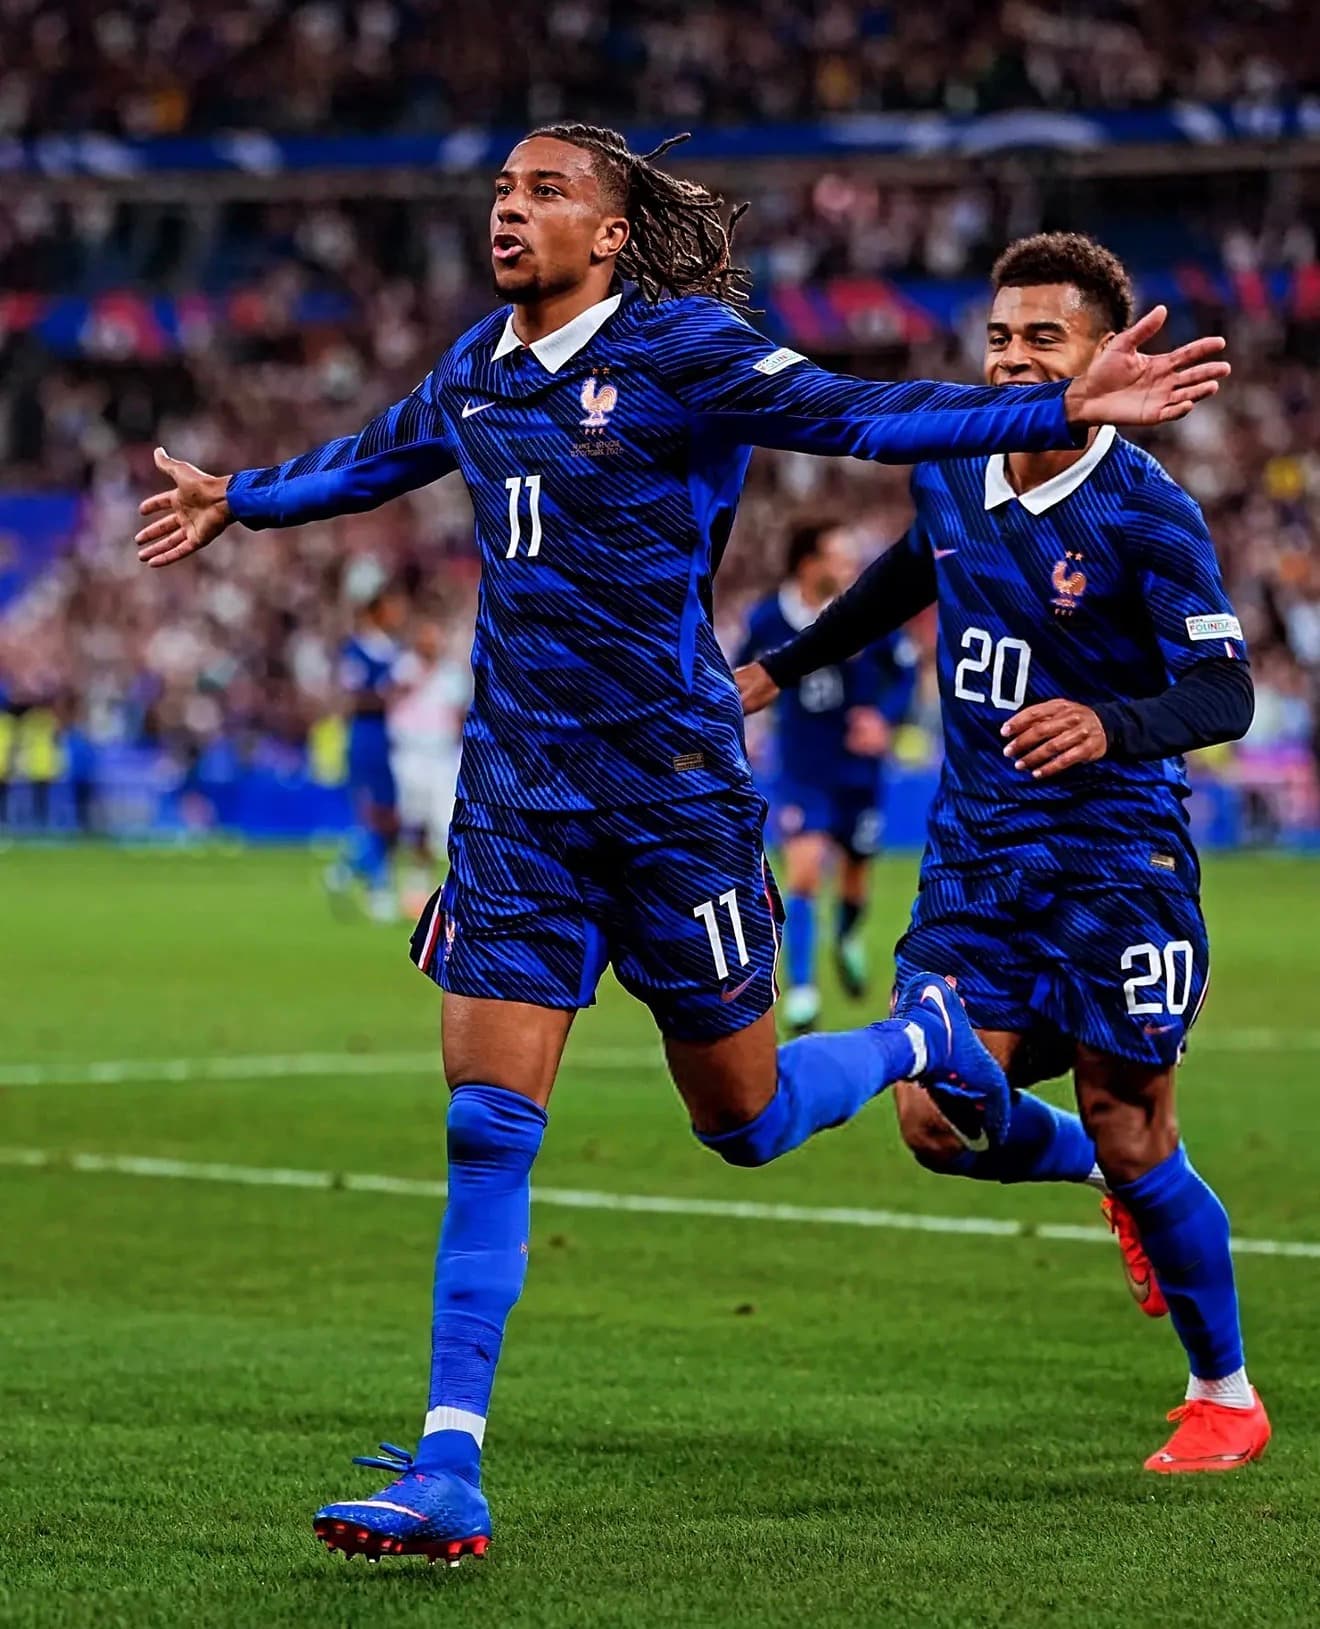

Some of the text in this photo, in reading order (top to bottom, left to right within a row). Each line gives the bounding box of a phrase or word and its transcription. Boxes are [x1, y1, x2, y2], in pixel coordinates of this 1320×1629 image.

[505, 475, 542, 558] 11
[955, 627, 1031, 711] 20
[693, 888, 750, 980] 11
[1121, 940, 1193, 1015] 20
